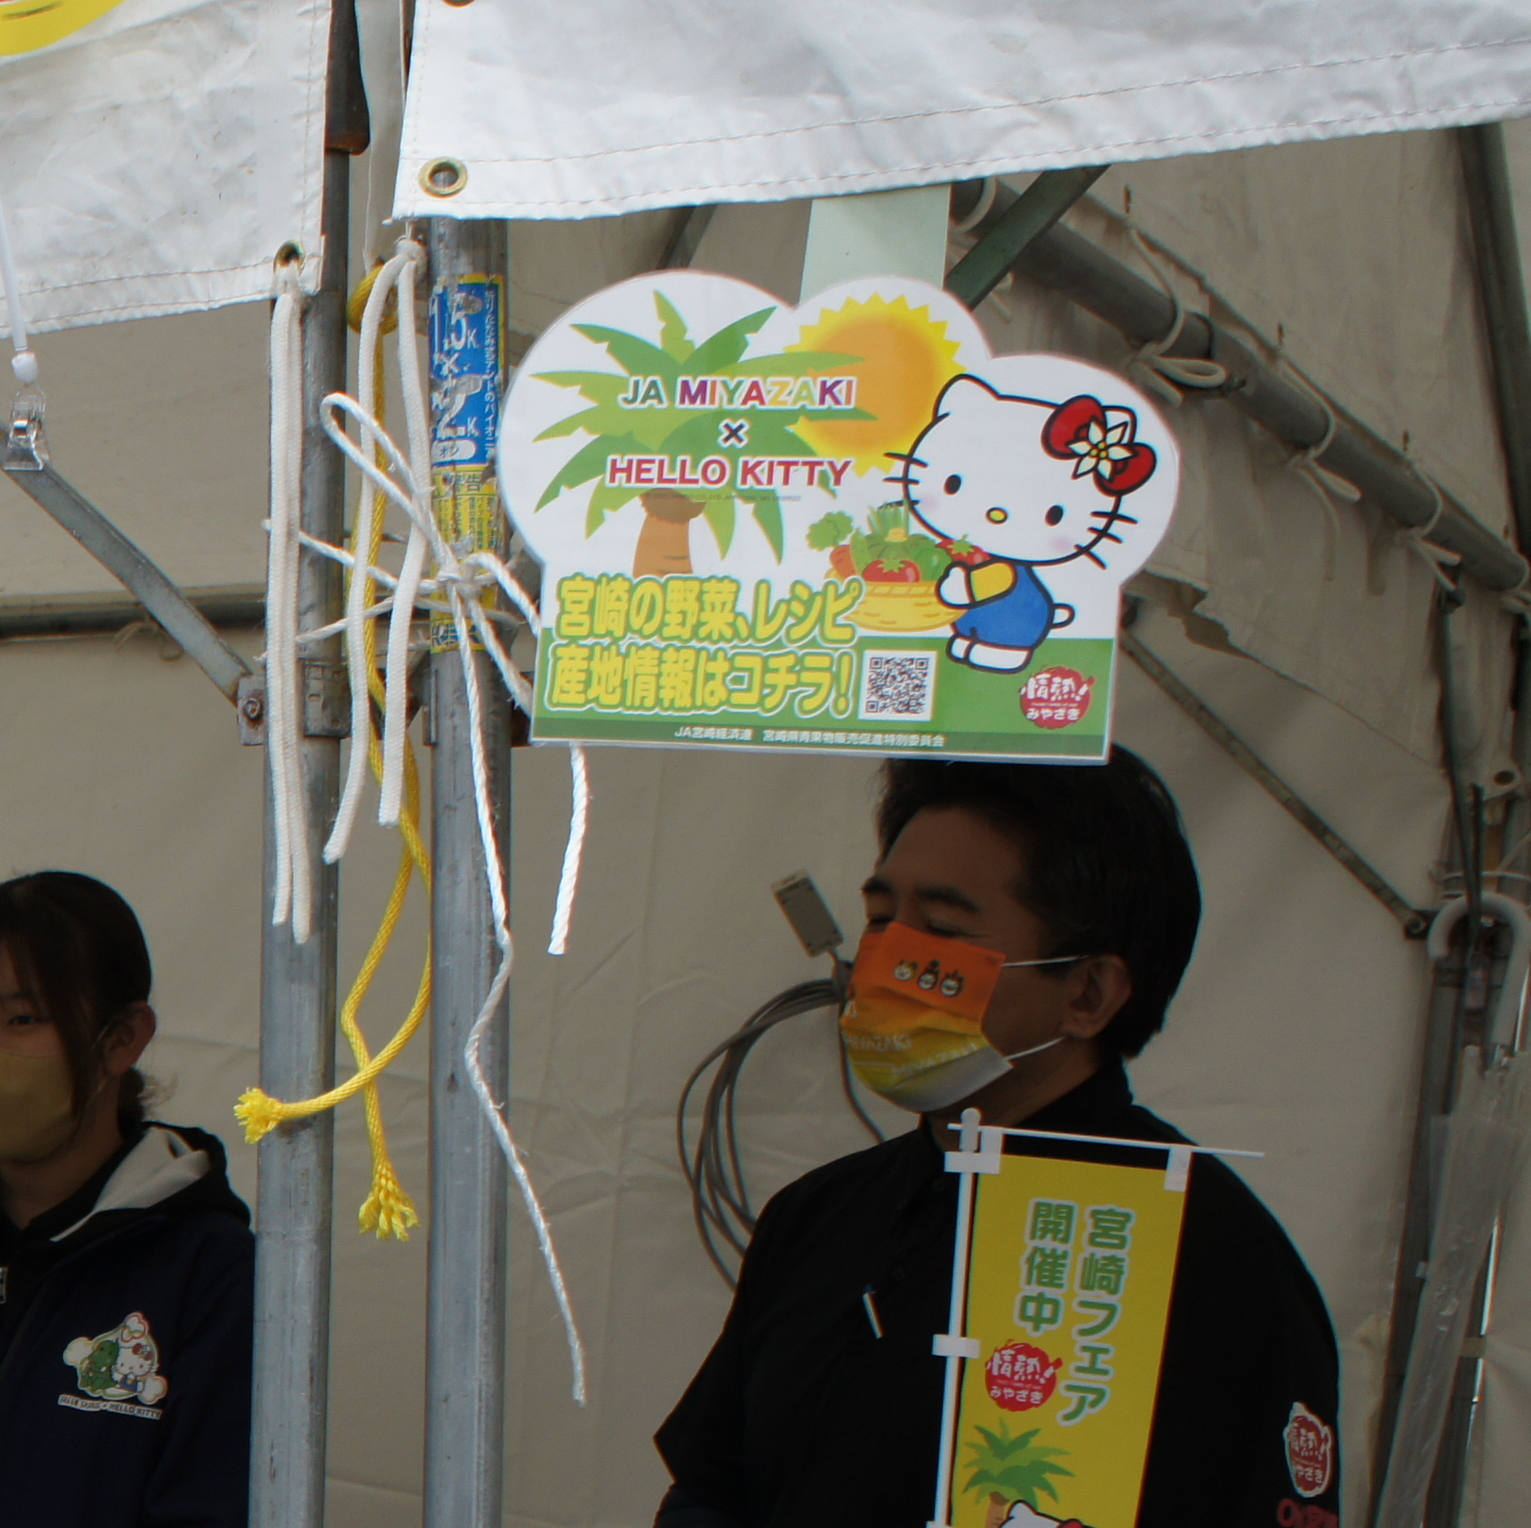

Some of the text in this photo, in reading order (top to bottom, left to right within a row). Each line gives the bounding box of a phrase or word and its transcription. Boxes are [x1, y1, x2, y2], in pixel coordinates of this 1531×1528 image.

[621, 379, 855, 406] JA MIYAZAKI
[608, 458, 853, 487] HELLO KITTY
[558, 575, 862, 641] 宮崎の野菜、レシピ
[552, 644, 851, 712] 産地情報はコチラ!
[1019, 1200, 1076, 1332] 開催中
[1062, 1208, 1132, 1422] 宮崎フェア
